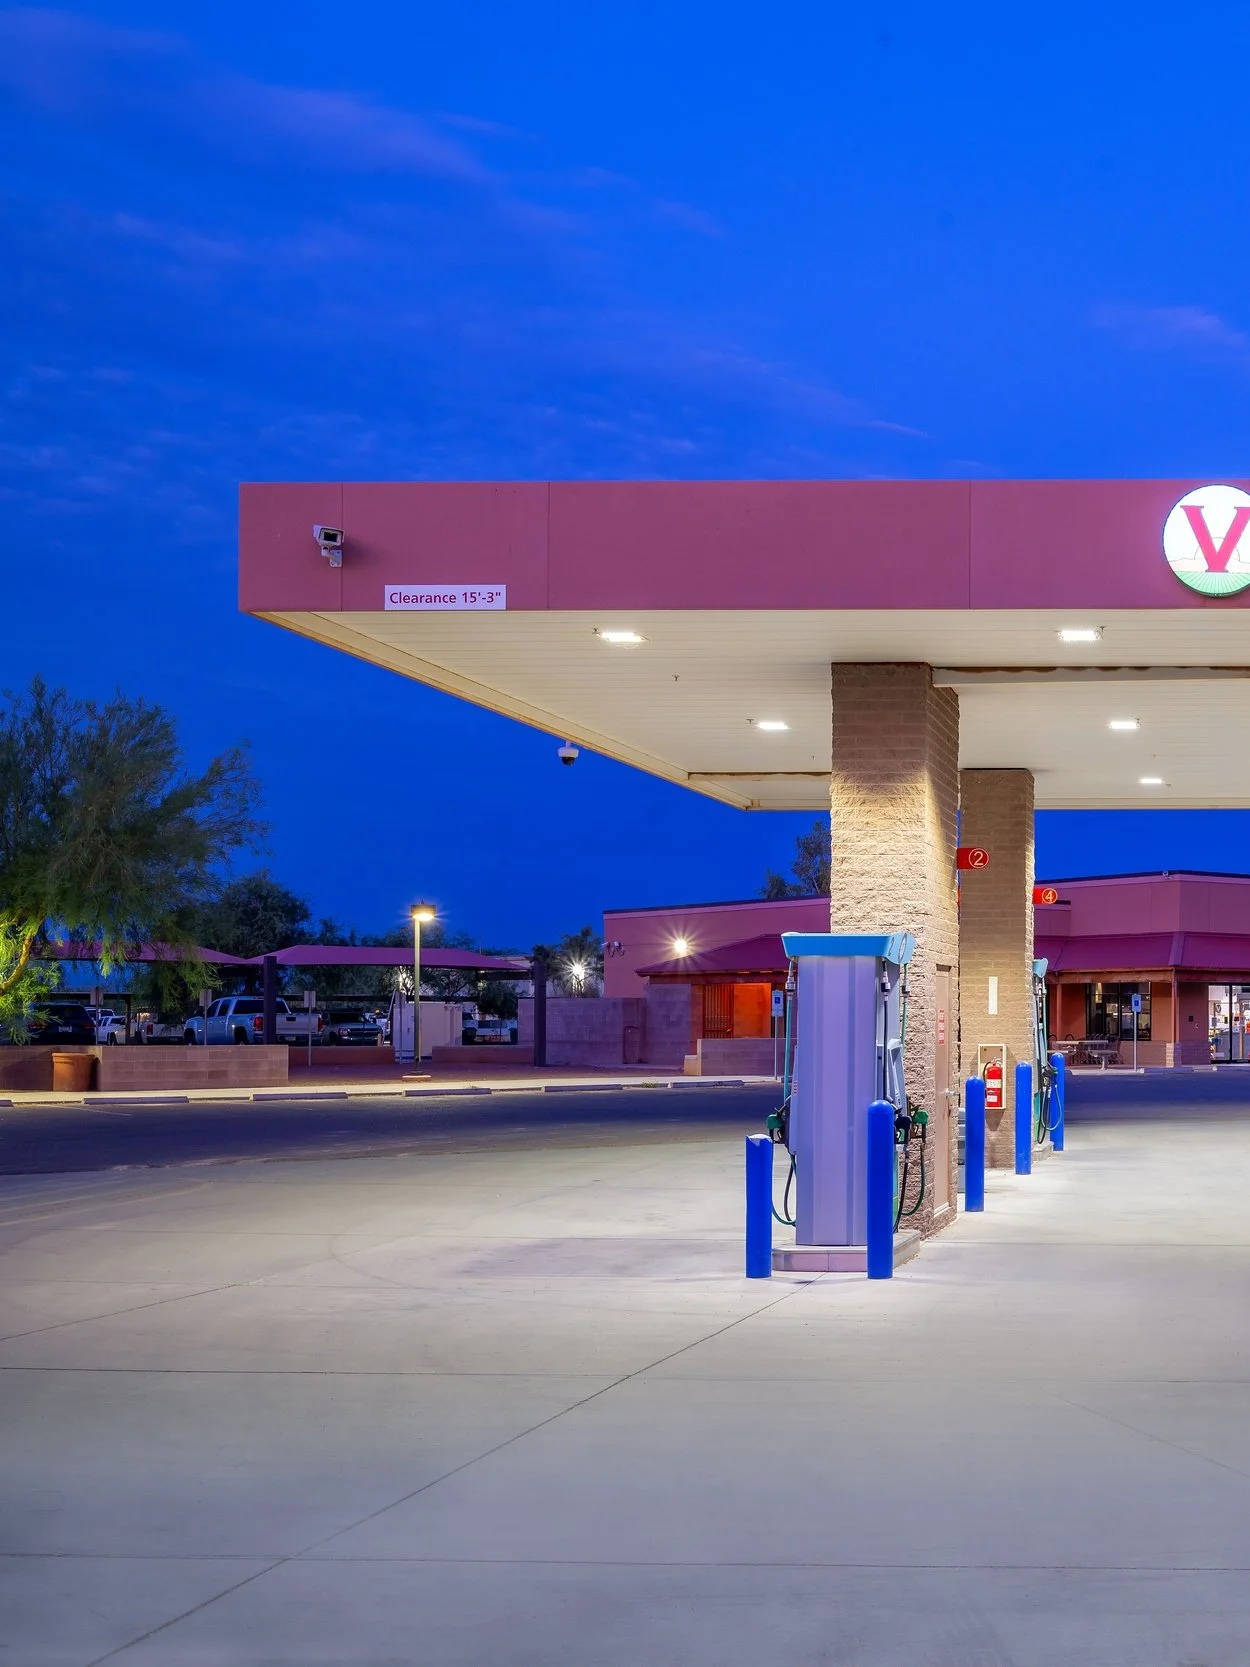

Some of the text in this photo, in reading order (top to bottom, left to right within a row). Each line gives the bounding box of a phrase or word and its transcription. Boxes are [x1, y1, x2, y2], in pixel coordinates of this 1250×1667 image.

[389, 591, 501, 604] Clearance 15'-3"
[973, 850, 984, 866] 2
[1045, 890, 1054, 903] 4
